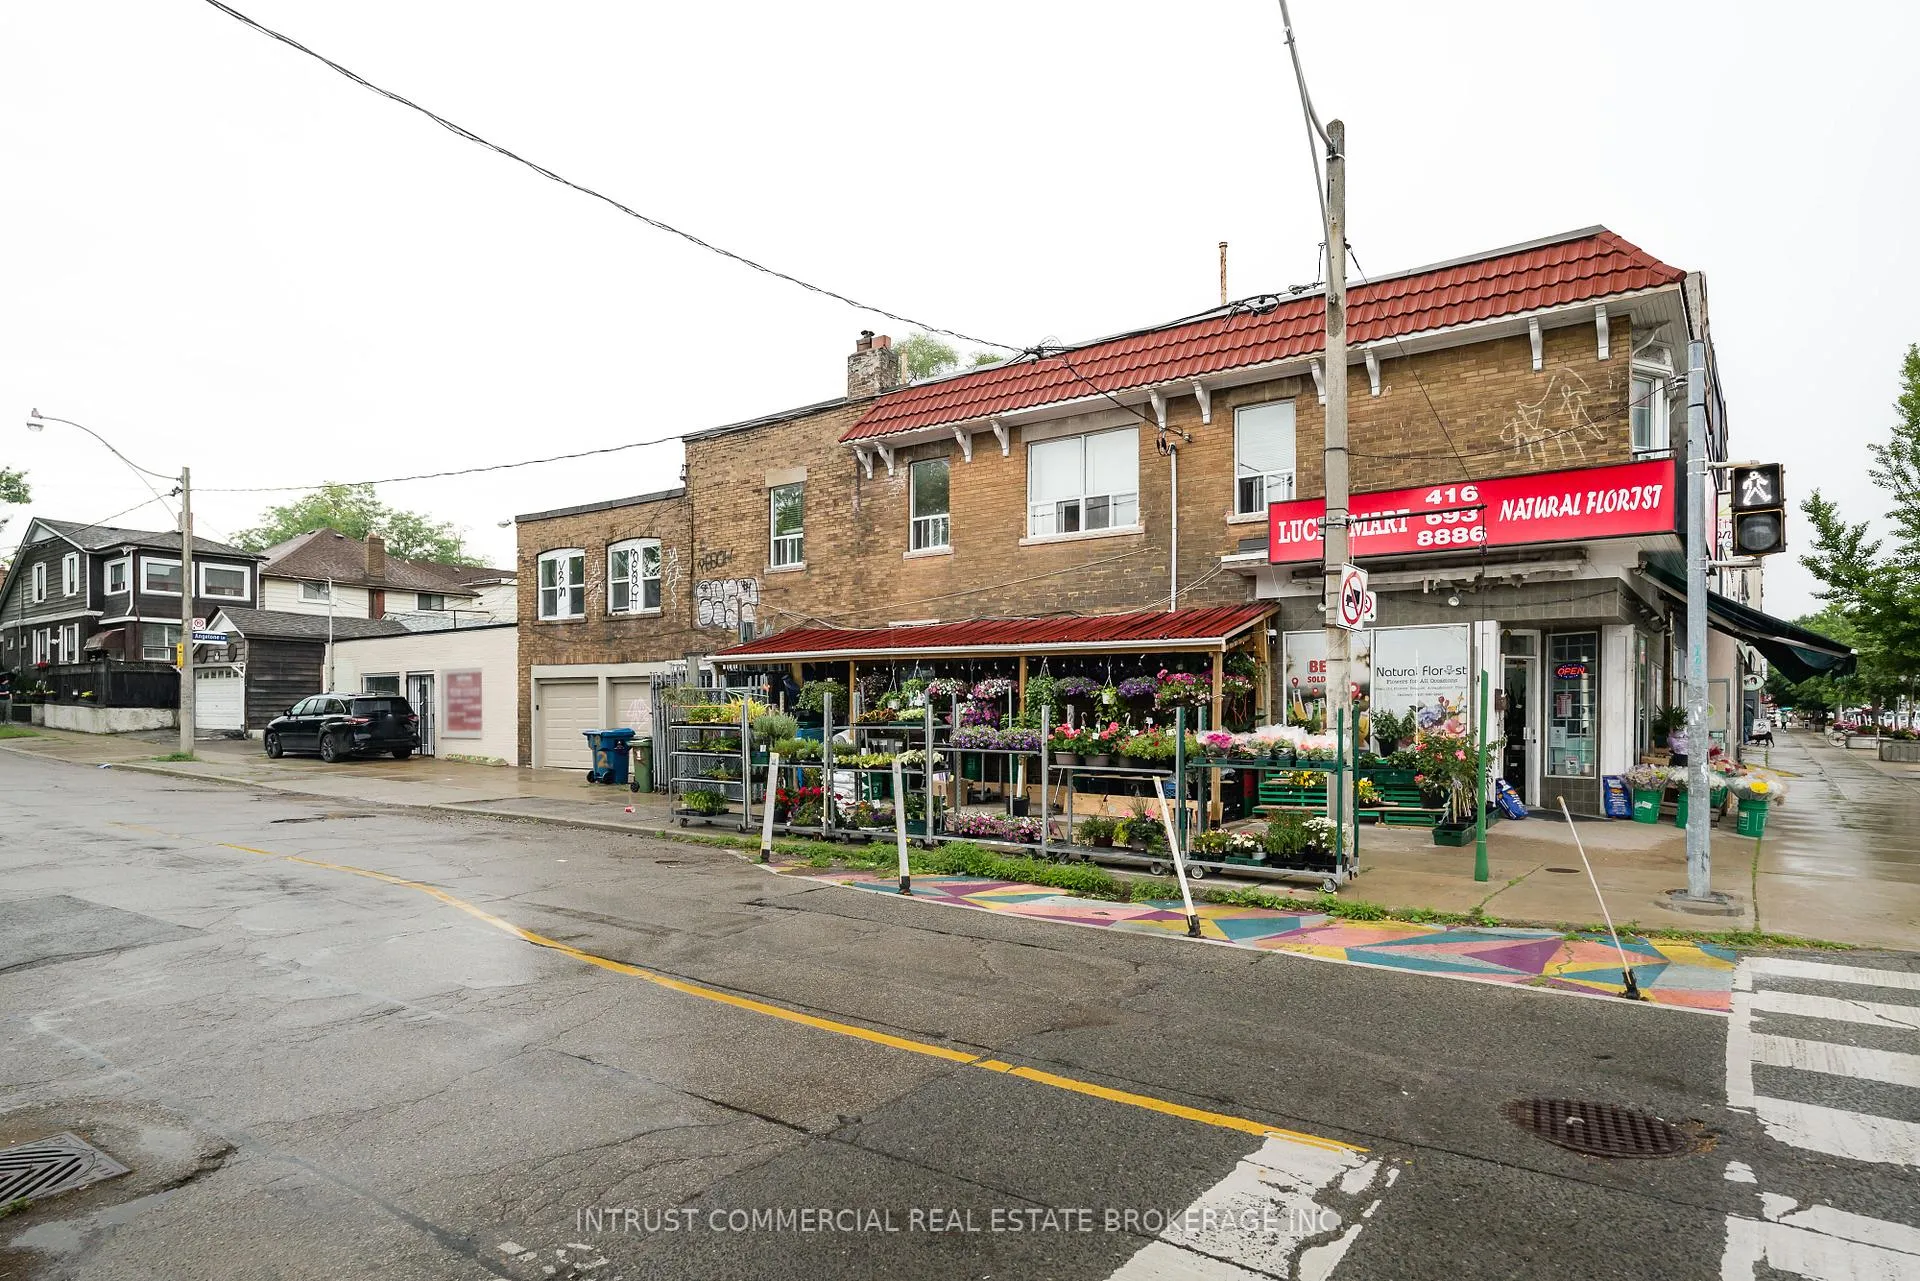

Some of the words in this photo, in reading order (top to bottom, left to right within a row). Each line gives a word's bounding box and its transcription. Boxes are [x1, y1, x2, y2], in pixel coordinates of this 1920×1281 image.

[1425, 485, 1478, 504] 416
[1425, 508, 1478, 525] 693
[1499, 492, 1582, 522] NATURAL
[1349, 508, 1410, 538] MART
[1416, 525, 1487, 546] 8886
[1307, 676, 1326, 684] SOLD
[1557, 667, 1585, 676] OPEN
